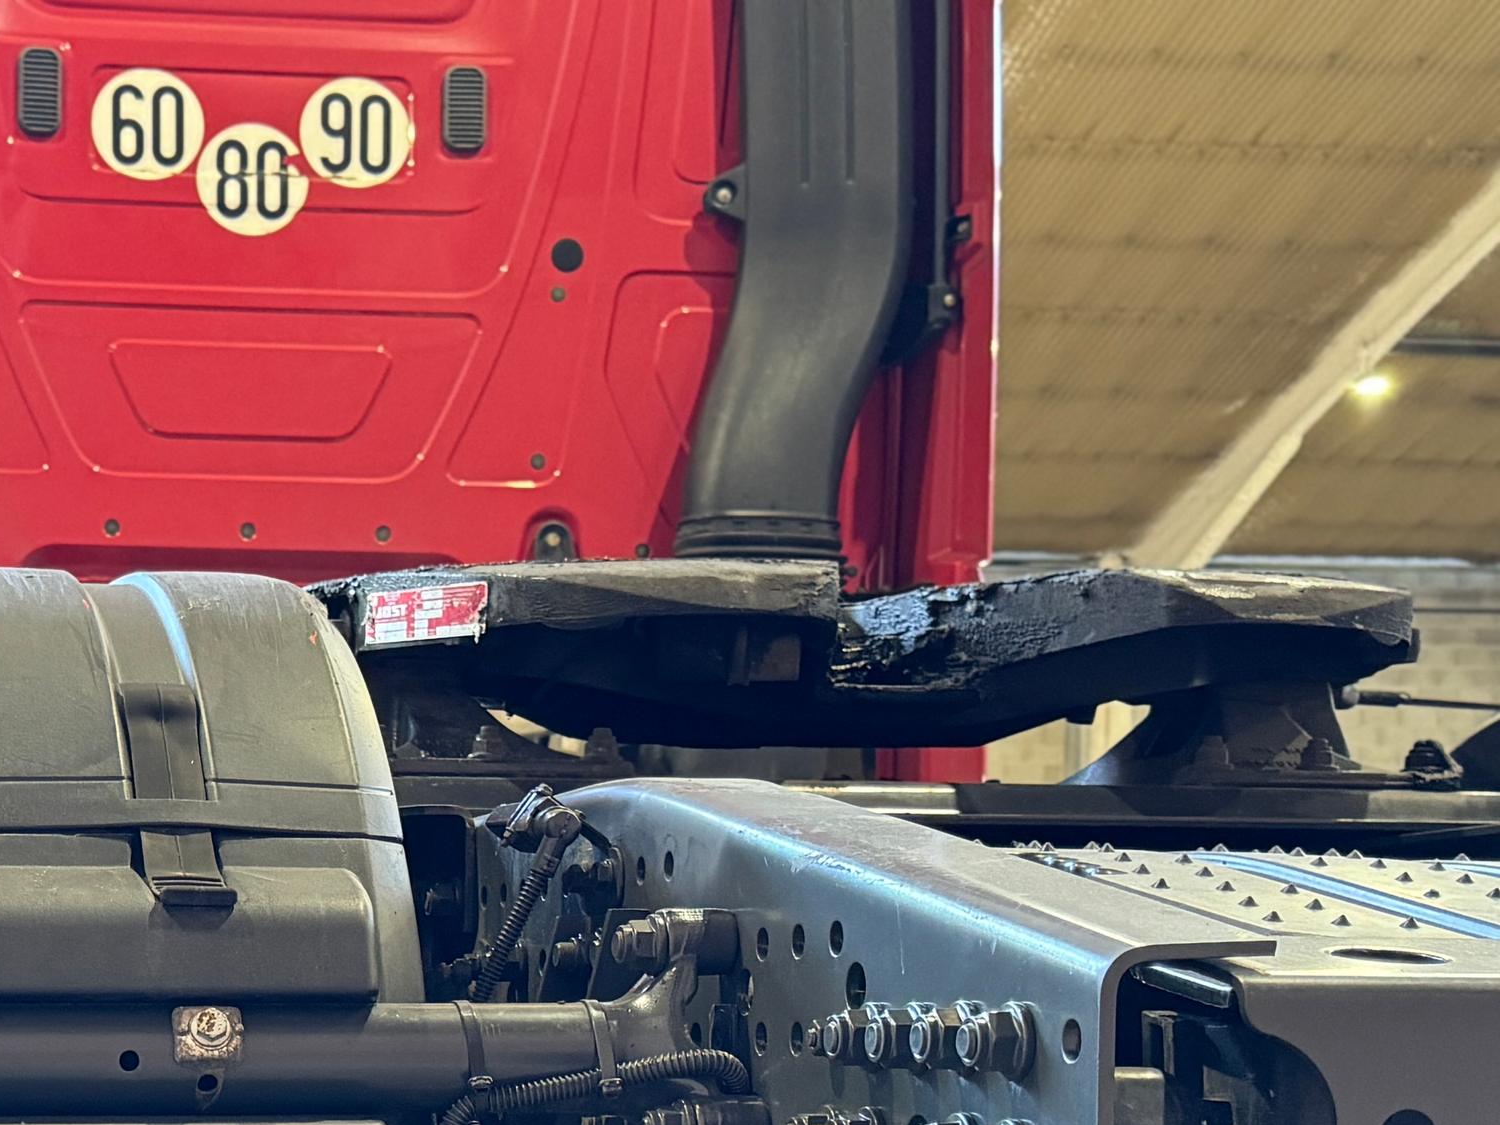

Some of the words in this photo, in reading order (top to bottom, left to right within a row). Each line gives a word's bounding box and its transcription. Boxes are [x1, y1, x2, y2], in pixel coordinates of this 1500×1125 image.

[111, 84, 184, 167] 60
[320, 92, 392, 175] 90
[216, 139, 289, 221] 80
[376, 604, 408, 619] JOST
